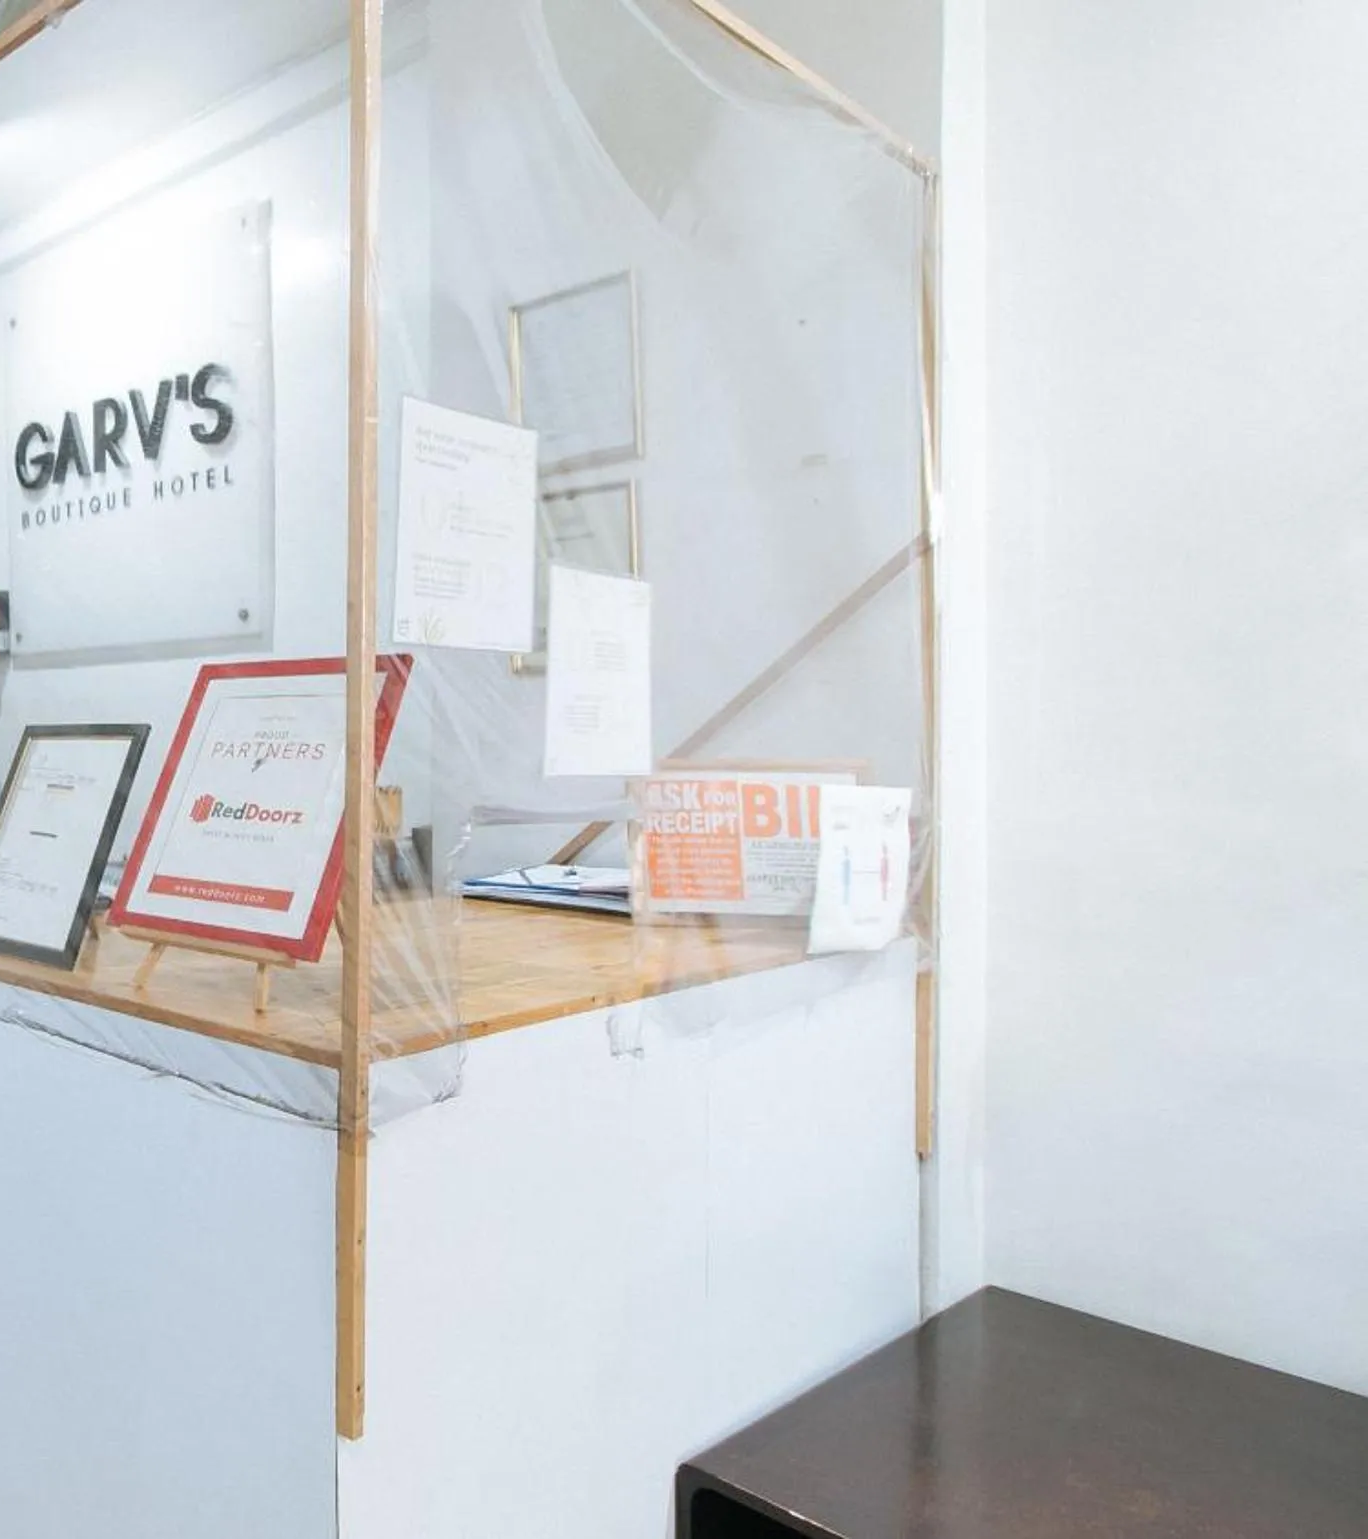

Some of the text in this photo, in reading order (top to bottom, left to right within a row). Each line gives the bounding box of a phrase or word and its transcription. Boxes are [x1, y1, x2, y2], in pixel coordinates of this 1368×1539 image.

[14, 363, 236, 490] GARV'S
[20, 466, 235, 530] BOUTIQUE HOTEL
[211, 741, 325, 760] PARTNERS
[645, 782, 701, 811] ASK
[211, 801, 305, 825] RedDoorz
[645, 811, 738, 834] RECEIPT
